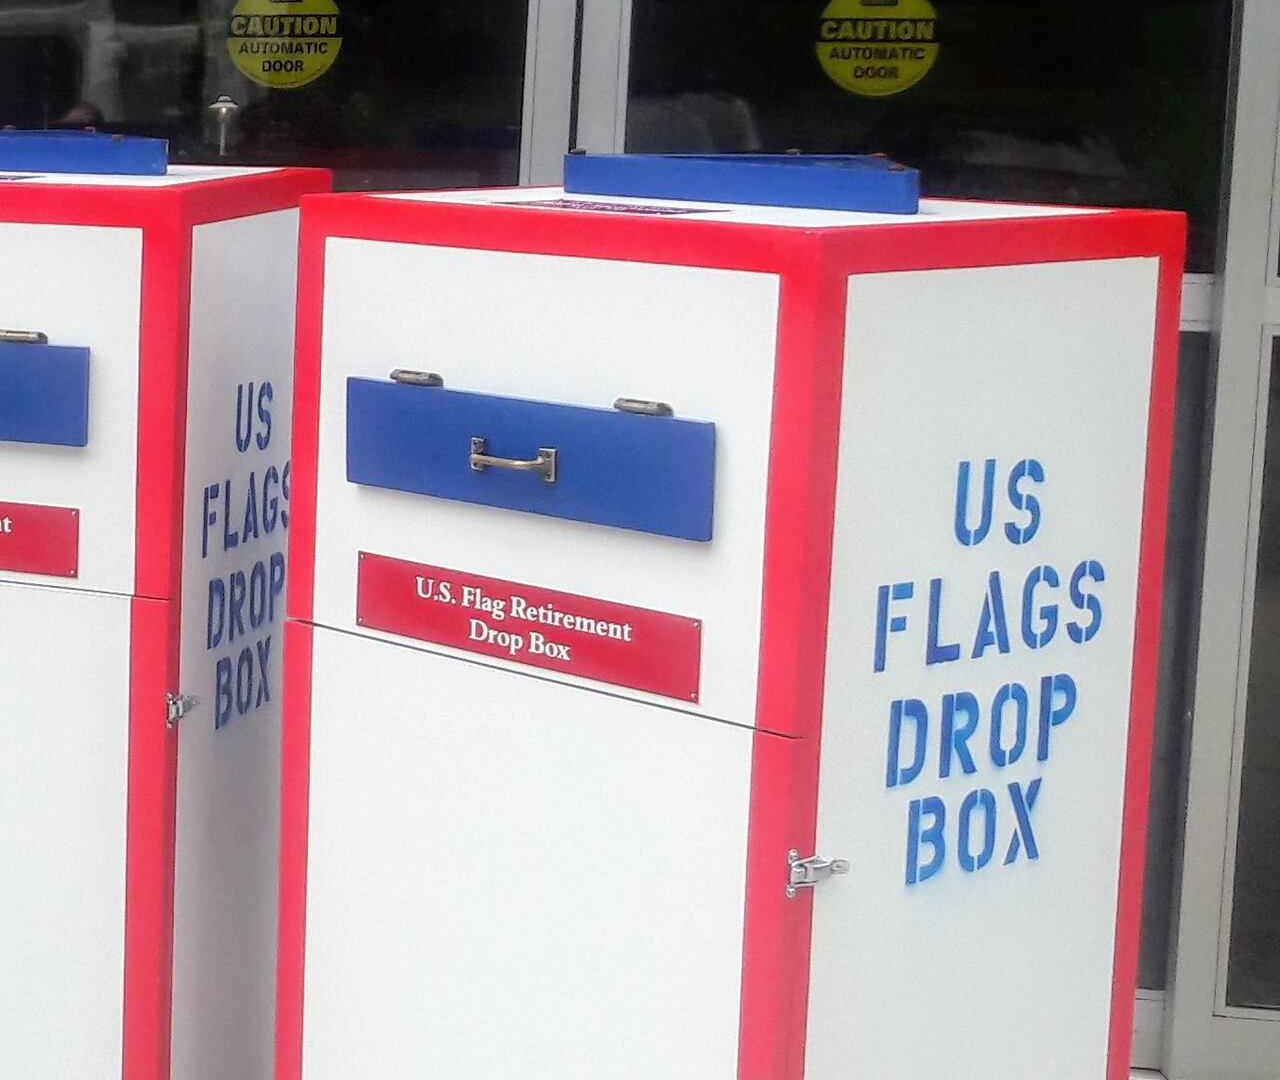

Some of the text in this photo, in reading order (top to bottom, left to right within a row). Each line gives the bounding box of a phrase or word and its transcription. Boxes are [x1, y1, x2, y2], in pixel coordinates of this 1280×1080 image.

[230, 15, 338, 36] CAUTION
[239, 41, 329, 55] AUTOMATIC
[820, 20, 935, 41] CAUTION
[829, 47, 926, 60] AUTOMATIC
[261, 60, 305, 73] DOOR
[853, 66, 900, 79] DOOR
[235, 380, 274, 454] US
[953, 457, 1047, 548] US
[206, 551, 286, 651] DROP
[414, 576, 633, 643] U.S. Flag Retirement
[873, 559, 1106, 673] FLAGS
[468, 618, 572, 661] Drop Box
[214, 635, 272, 731] BOX
[884, 672, 1078, 789] DROP
[904, 776, 1044, 886] BOX
